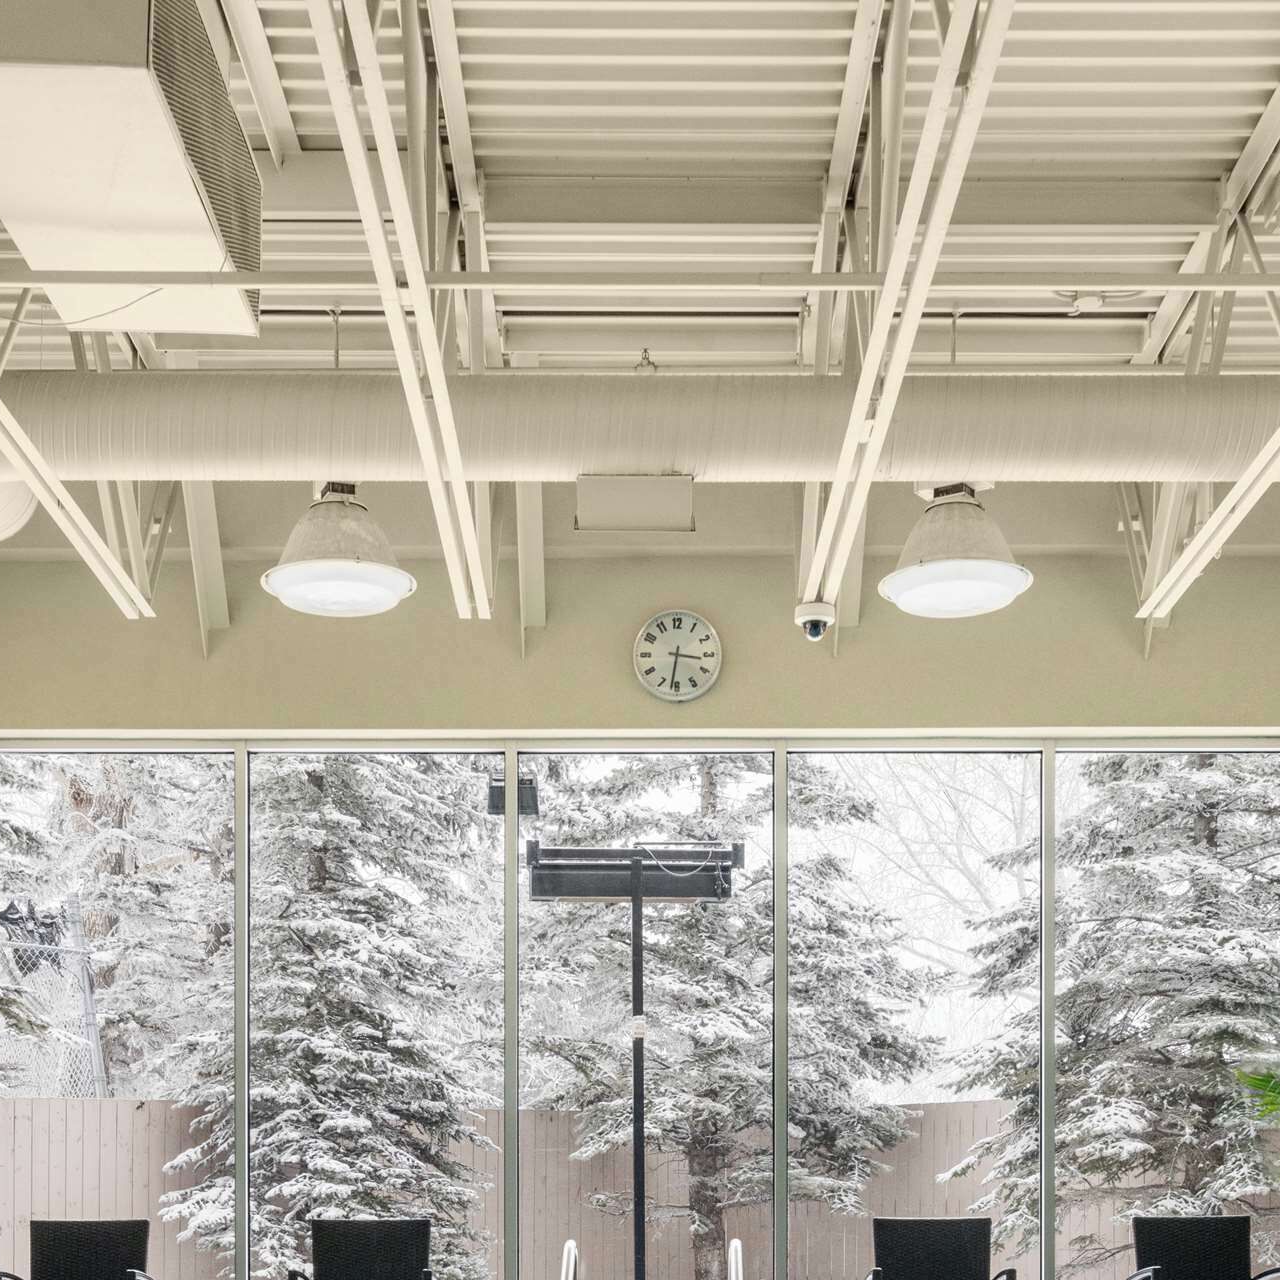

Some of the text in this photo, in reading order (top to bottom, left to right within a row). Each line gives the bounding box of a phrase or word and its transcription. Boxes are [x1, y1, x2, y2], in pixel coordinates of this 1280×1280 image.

[656, 620, 667, 633] 11
[672, 617, 682, 629] 12
[690, 623, 697, 632] 1
[644, 632, 657, 644] 10
[699, 634, 710, 644] 2
[644, 666, 656, 676] 8
[657, 677, 666, 687] 7
[674, 681, 680, 692] 6
[688, 676, 698, 688] 5
